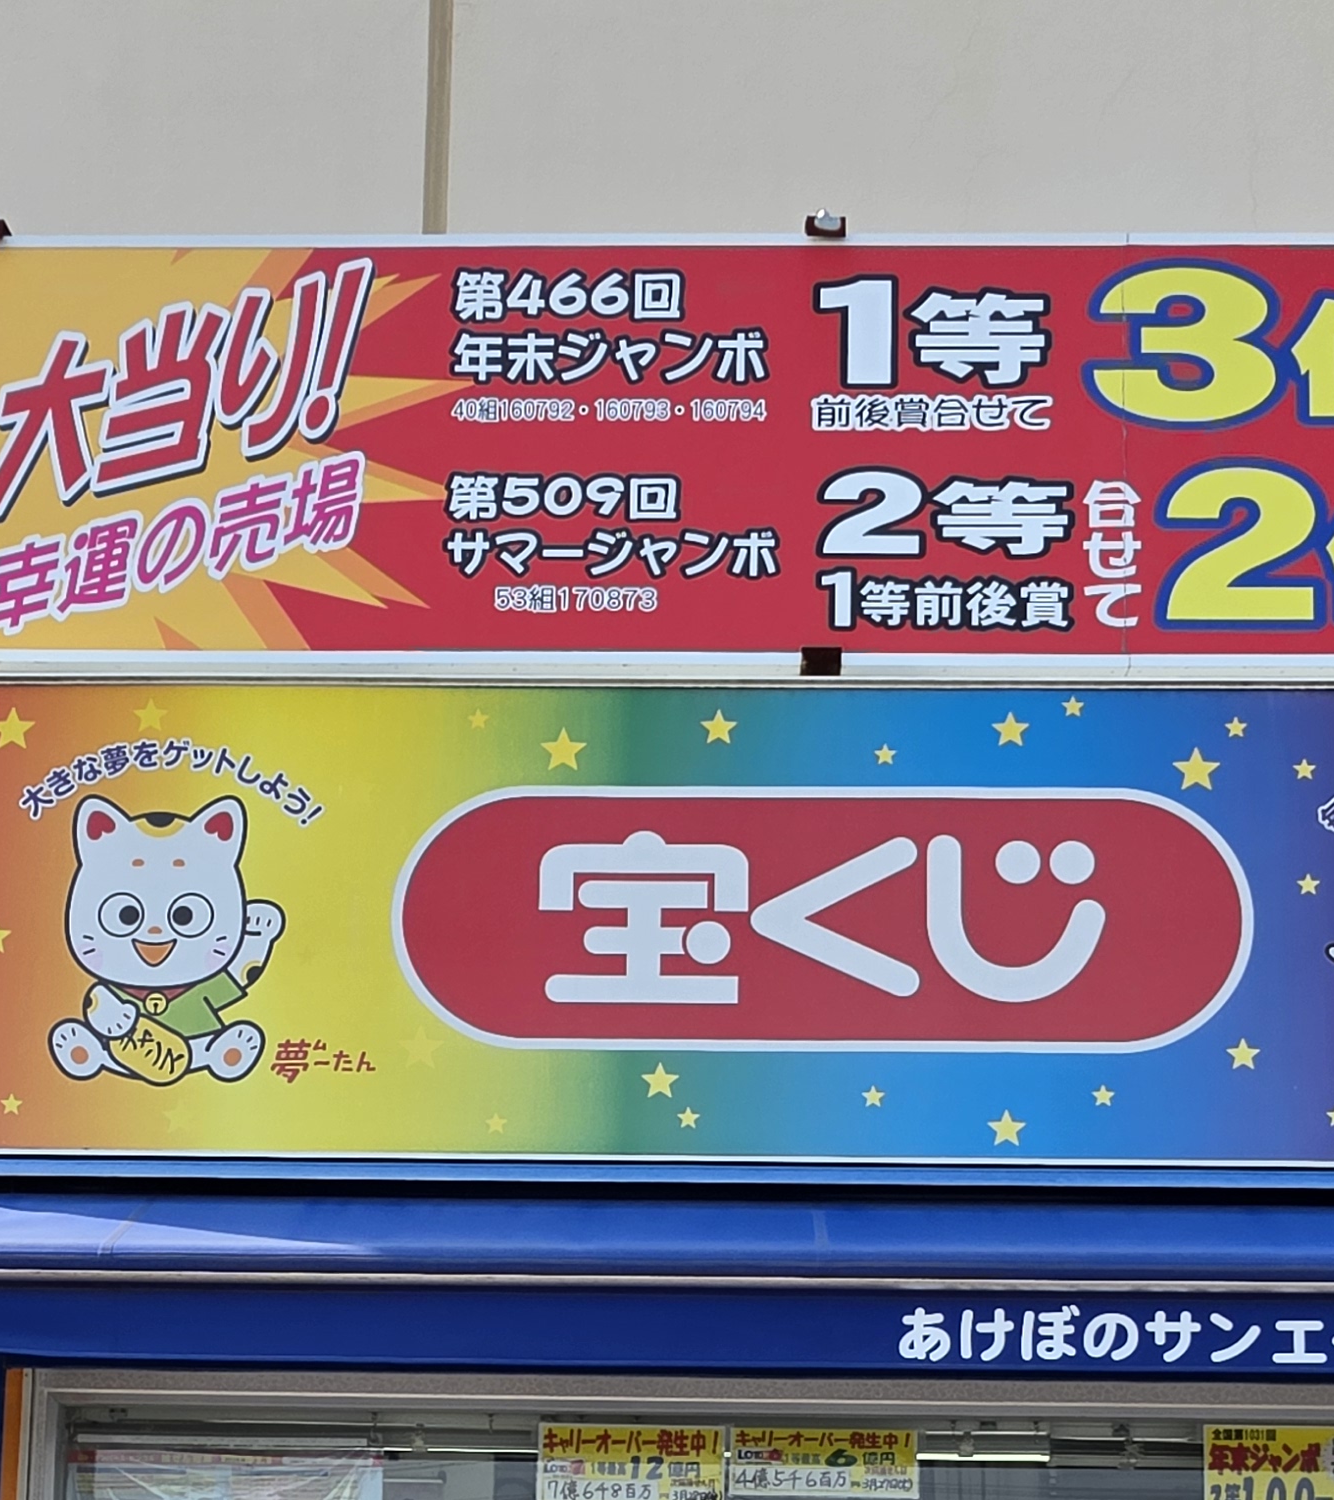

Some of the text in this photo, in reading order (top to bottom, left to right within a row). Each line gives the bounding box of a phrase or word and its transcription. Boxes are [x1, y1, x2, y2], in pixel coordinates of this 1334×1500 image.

[454, 269, 682, 320] 第466回
[452, 331, 768, 384] 年末ジャンボ
[815, 276, 1050, 388] 1等
[814, 397, 1052, 430] 前後賞合せて
[447, 475, 679, 520] 第509回
[820, 470, 1070, 558] 2等
[445, 530, 779, 578] サマージャンボ
[1083, 480, 1142, 628] 合せて
[494, 587, 658, 612] 53組170873
[820, 570, 1070, 630] 1等前後賞
[19, 738, 324, 826] 大きな夢をゲットしよう!
[539, 830, 1106, 1004] 宝くじ
[543, 1427, 719, 1456] キャリーオーバー発生中!
[735, 1430, 911, 1450] キャリーオーバー発生中!
